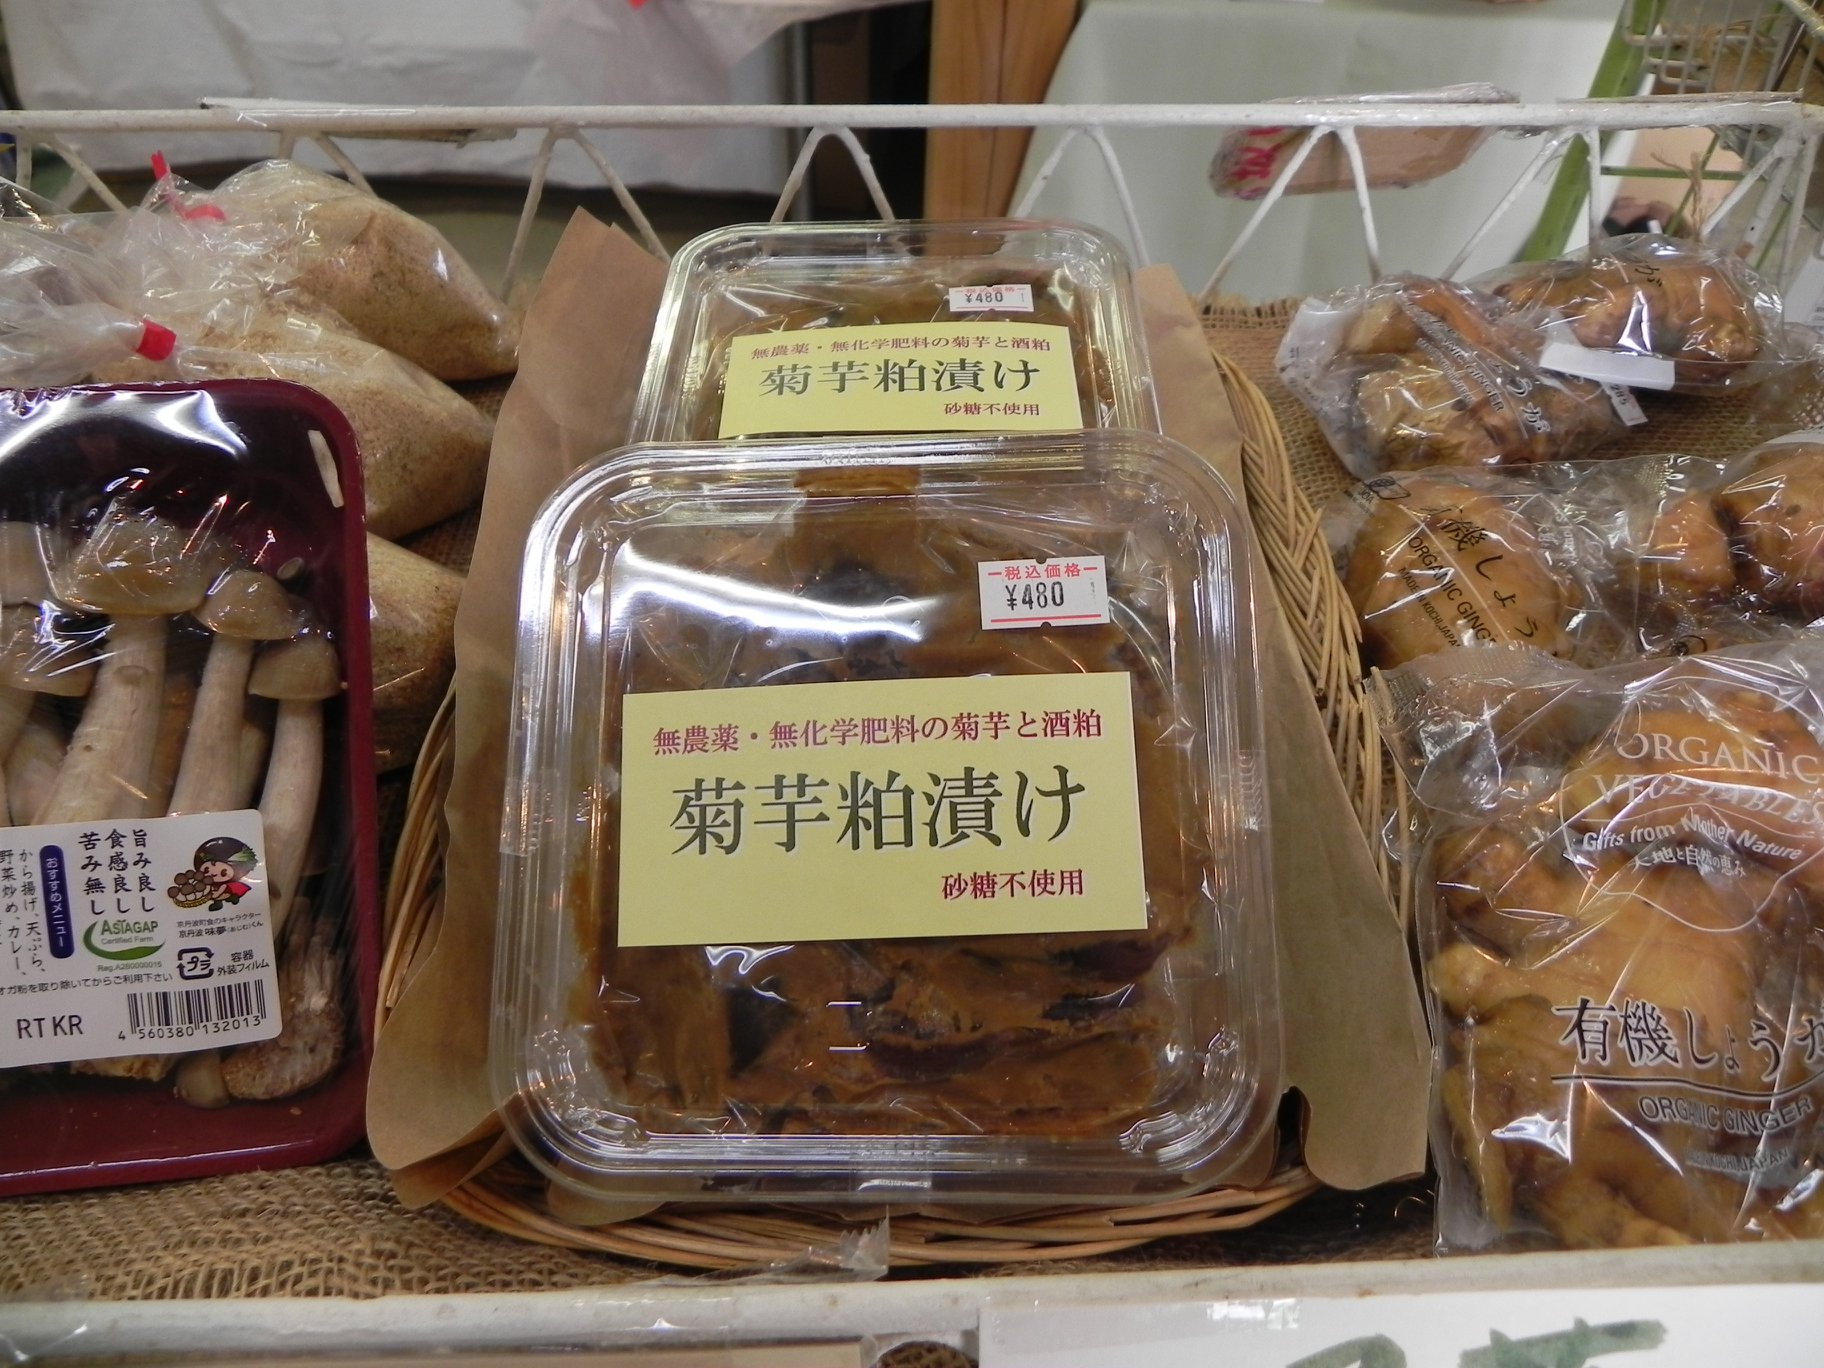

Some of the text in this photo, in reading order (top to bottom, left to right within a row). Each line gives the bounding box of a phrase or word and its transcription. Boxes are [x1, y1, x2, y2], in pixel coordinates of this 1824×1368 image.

[964, 291, 1004, 303] ¥480
[751, 336, 1051, 360] 無農薬・無化学肥料の菊芋と酒粕
[759, 357, 1040, 397] 菊芋粕漬け
[943, 402, 1040, 416] 砂糖不使用
[1004, 562, 1081, 581] 税込価格
[1005, 581, 1064, 611] ¥480
[653, 708, 1102, 757] 無農薬・無化学肥料の菊芋と酒粕
[1616, 732, 1820, 785] ORGANIC
[669, 764, 1086, 856] 菊芋粕漬け
[1630, 823, 1676, 843] from
[1736, 829, 1802, 861] Nature
[78, 831, 106, 915] 苦み無し
[104, 828, 132, 914] 食感良し
[132, 828, 157, 913] 旨み良し
[941, 868, 1084, 900] 砂糖不使用
[46, 857, 66, 947] おすすめメニュー
[217, 958, 270, 976] 外装フィルム
[230, 949, 254, 963] 容器
[1722, 1096, 1816, 1136] GINGER
